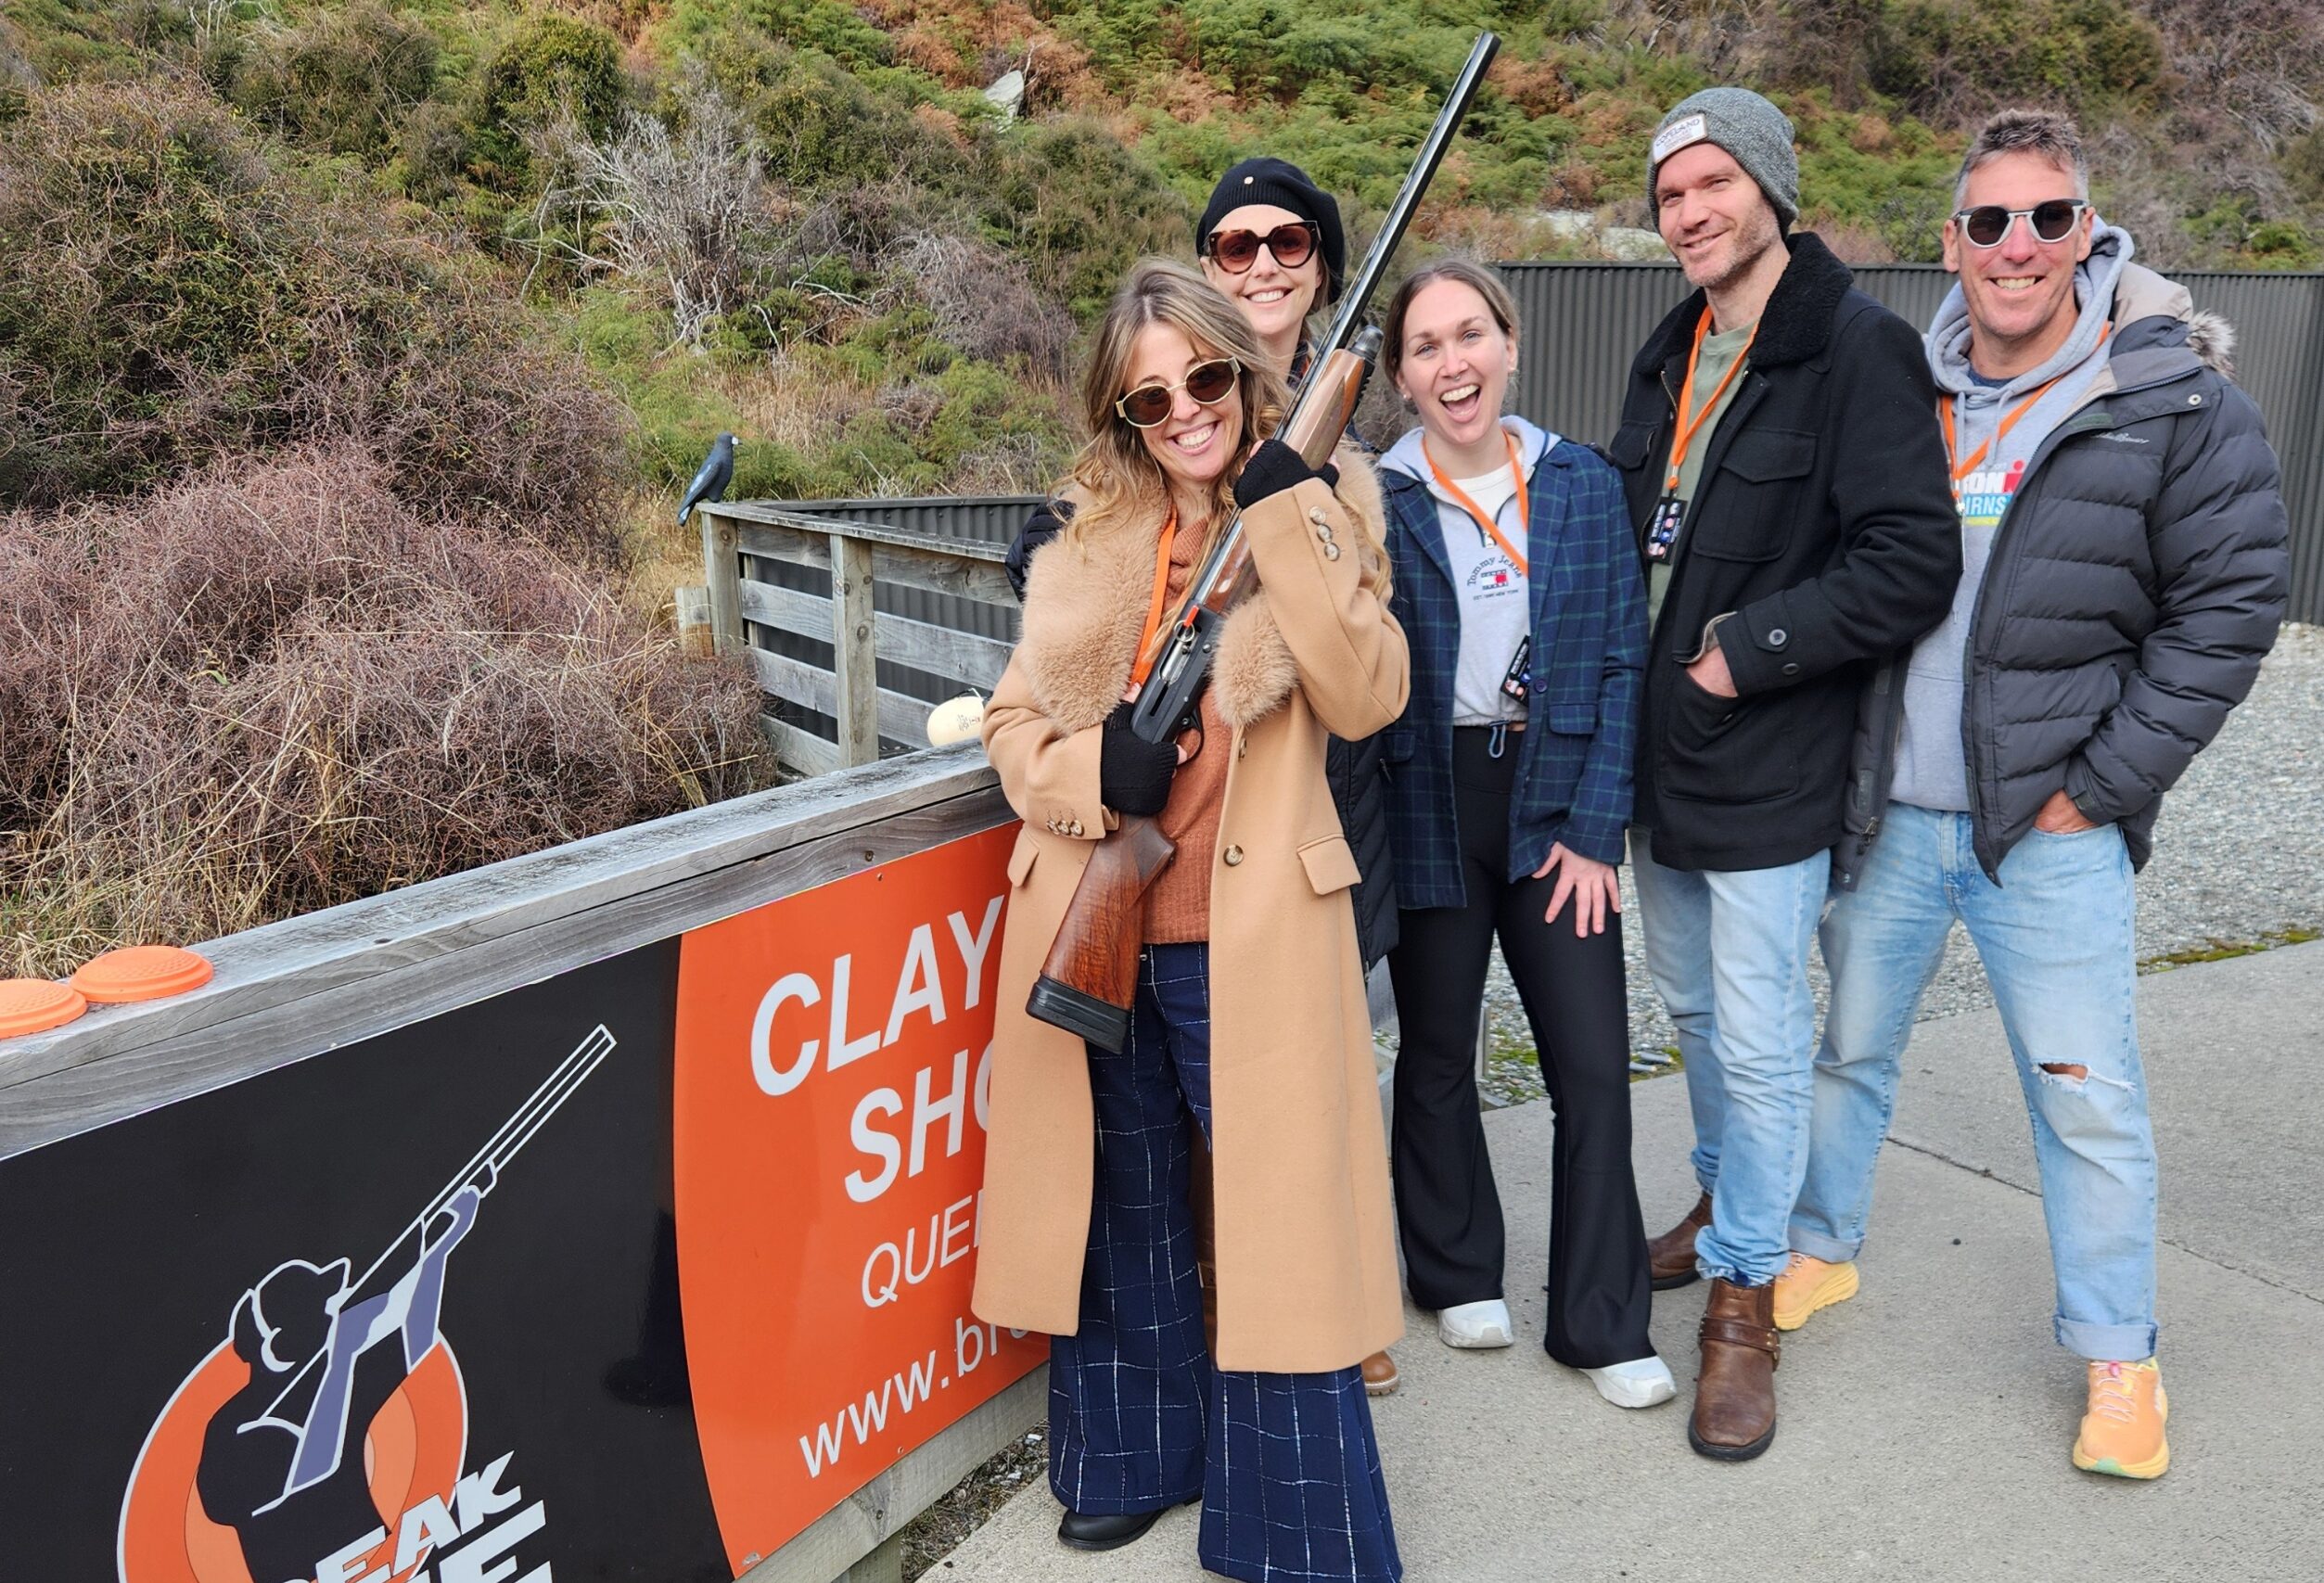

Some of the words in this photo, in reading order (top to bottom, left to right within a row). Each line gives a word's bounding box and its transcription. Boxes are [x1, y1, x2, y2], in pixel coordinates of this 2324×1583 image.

[1965, 495, 2008, 516] IRNS
[1467, 556, 1495, 586] Tommy
[1499, 555, 1522, 579] Jeans
[750, 894, 1005, 1096] CLAY
[283, 1449, 522, 1583] EAK
